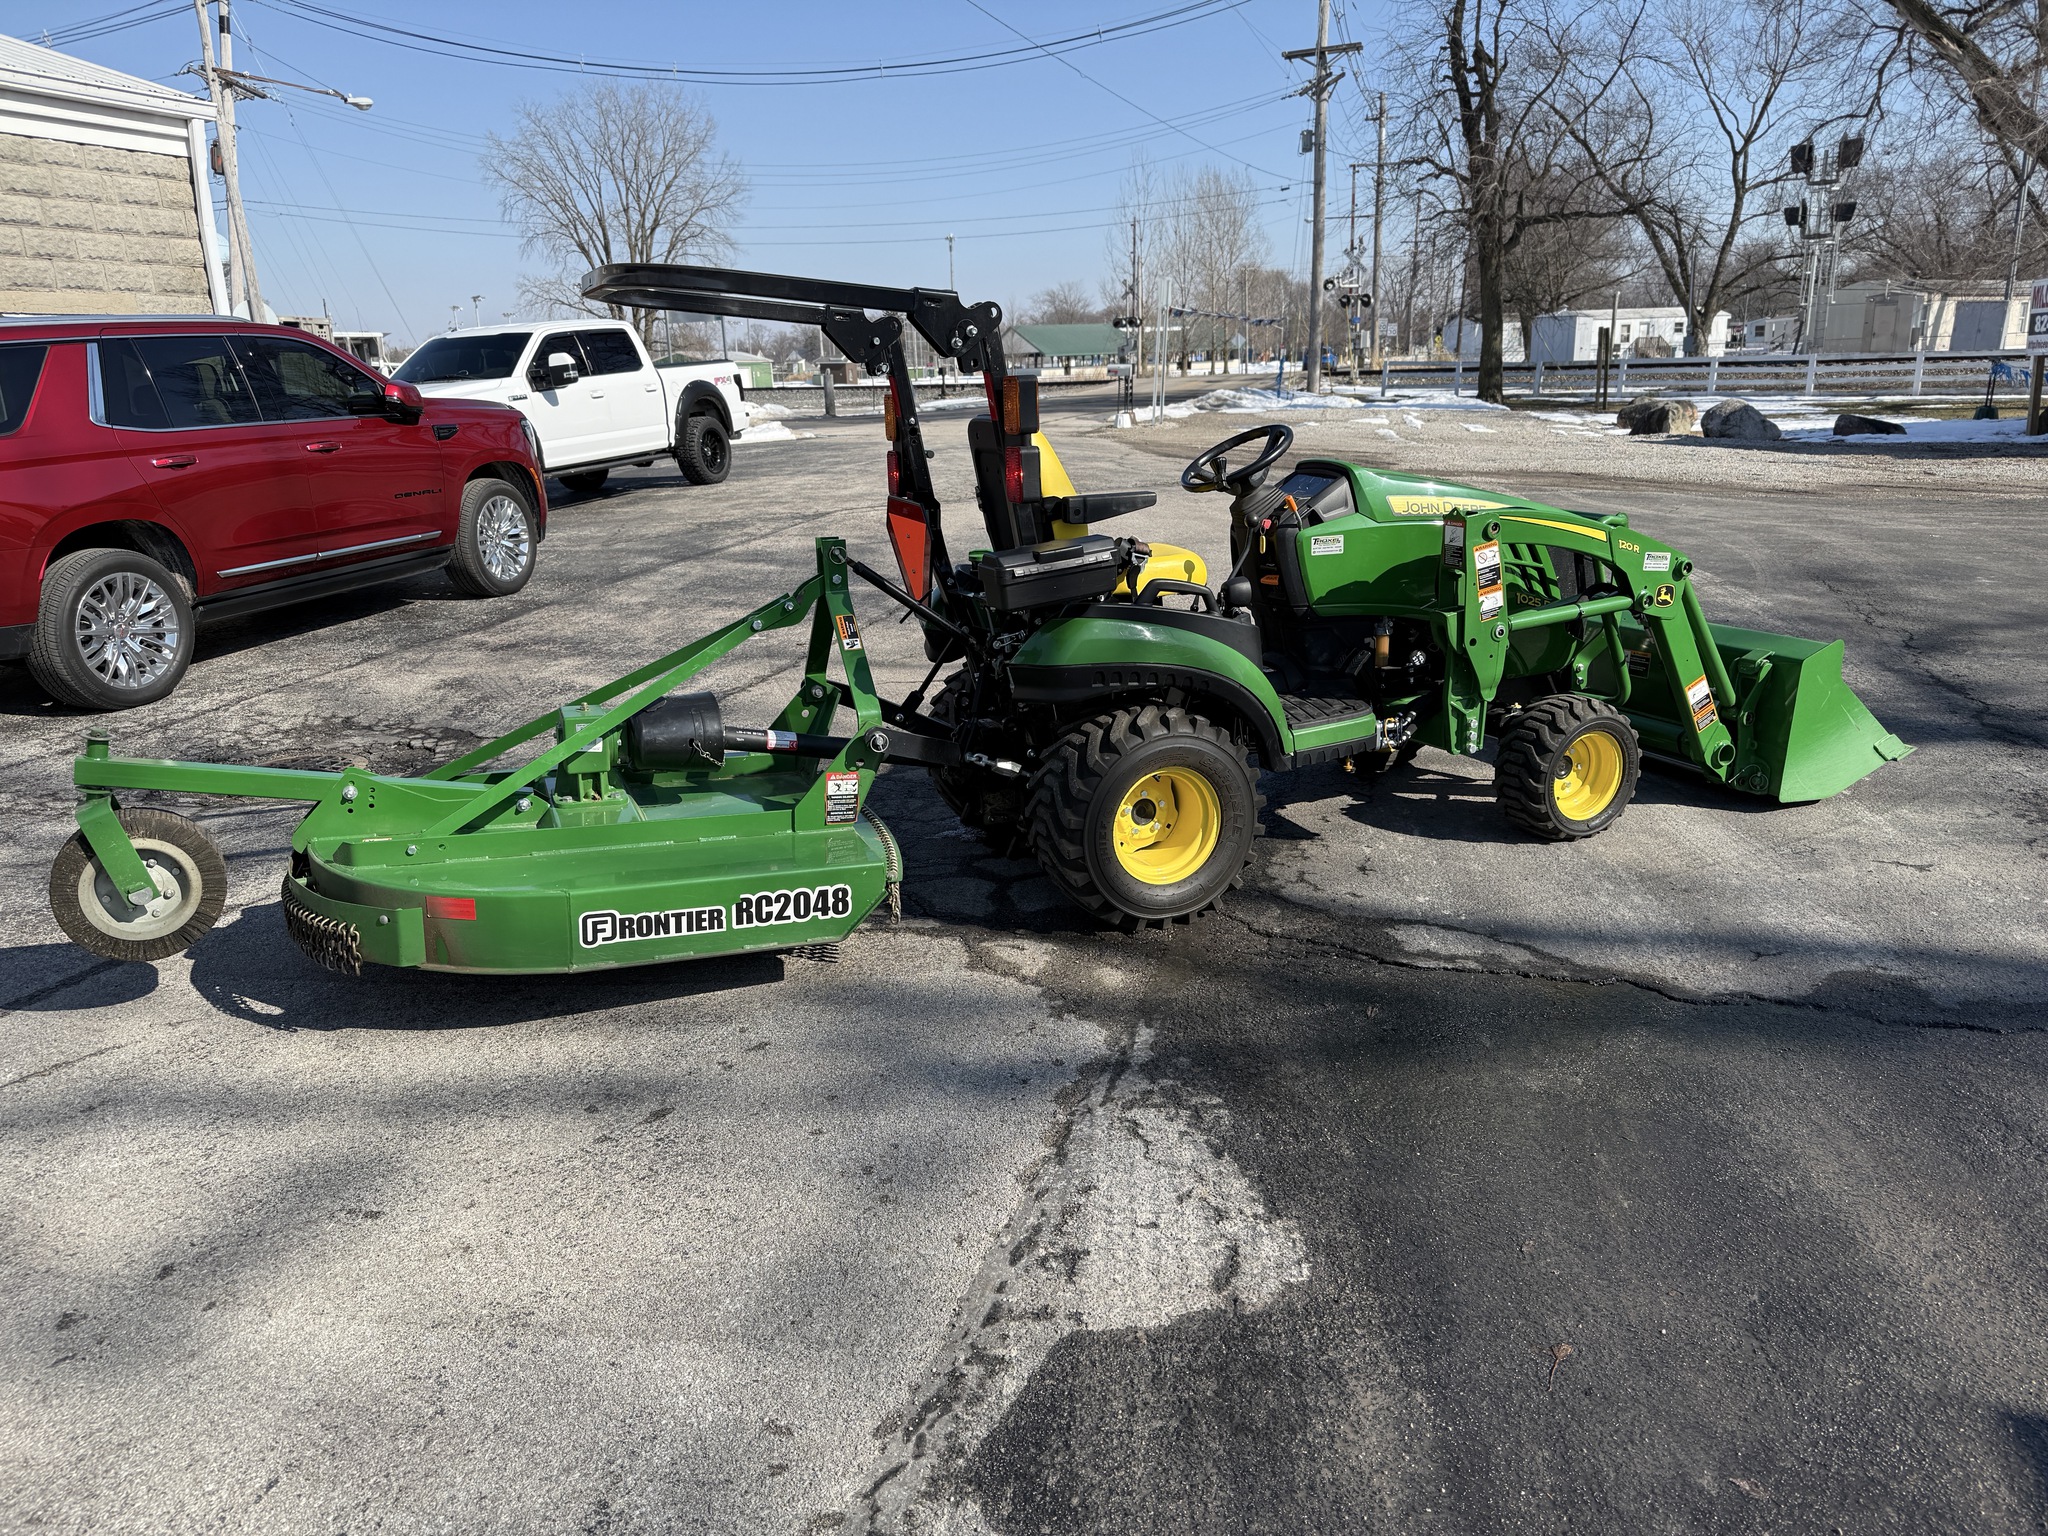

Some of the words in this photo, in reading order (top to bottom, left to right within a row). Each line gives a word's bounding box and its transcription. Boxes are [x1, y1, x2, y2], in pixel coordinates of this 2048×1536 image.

[2034, 314, 2048, 332] 82
[714, 375, 732, 385] FX4
[394, 488, 442, 499] DENALI
[1403, 501, 1440, 513] JOHN
[582, 908, 724, 946] FRONTIER
[735, 886, 849, 926] RC2048
